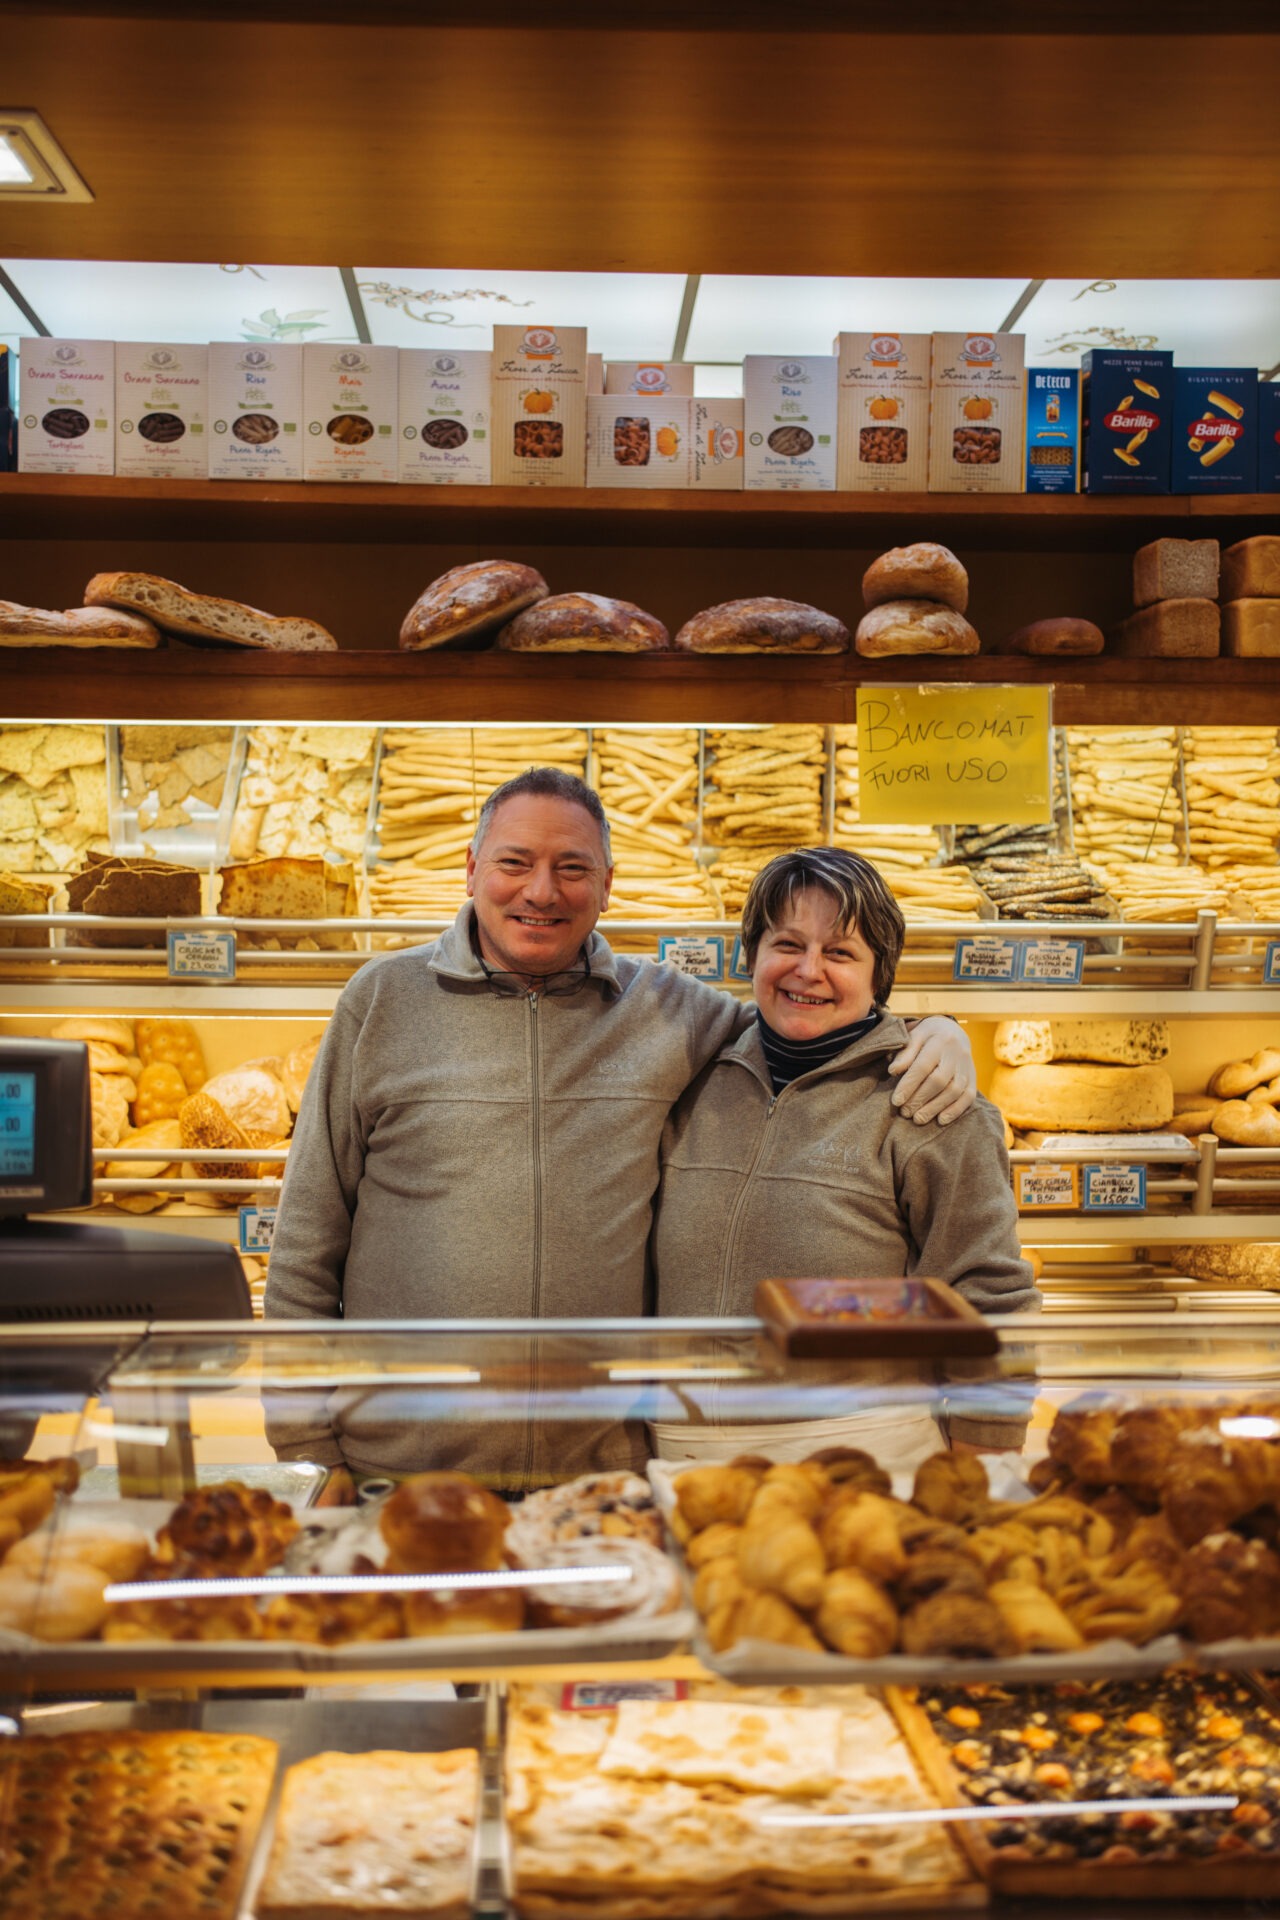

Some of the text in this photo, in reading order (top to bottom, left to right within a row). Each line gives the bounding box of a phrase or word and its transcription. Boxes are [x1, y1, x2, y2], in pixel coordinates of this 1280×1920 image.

[1047, 375, 1071, 389] CECCO
[1110, 415, 1155, 428] Barilla
[1194, 423, 1239, 437] Barilla
[860, 700, 1034, 753] BANCOMAT
[864, 757, 1007, 790] FUORI USO
